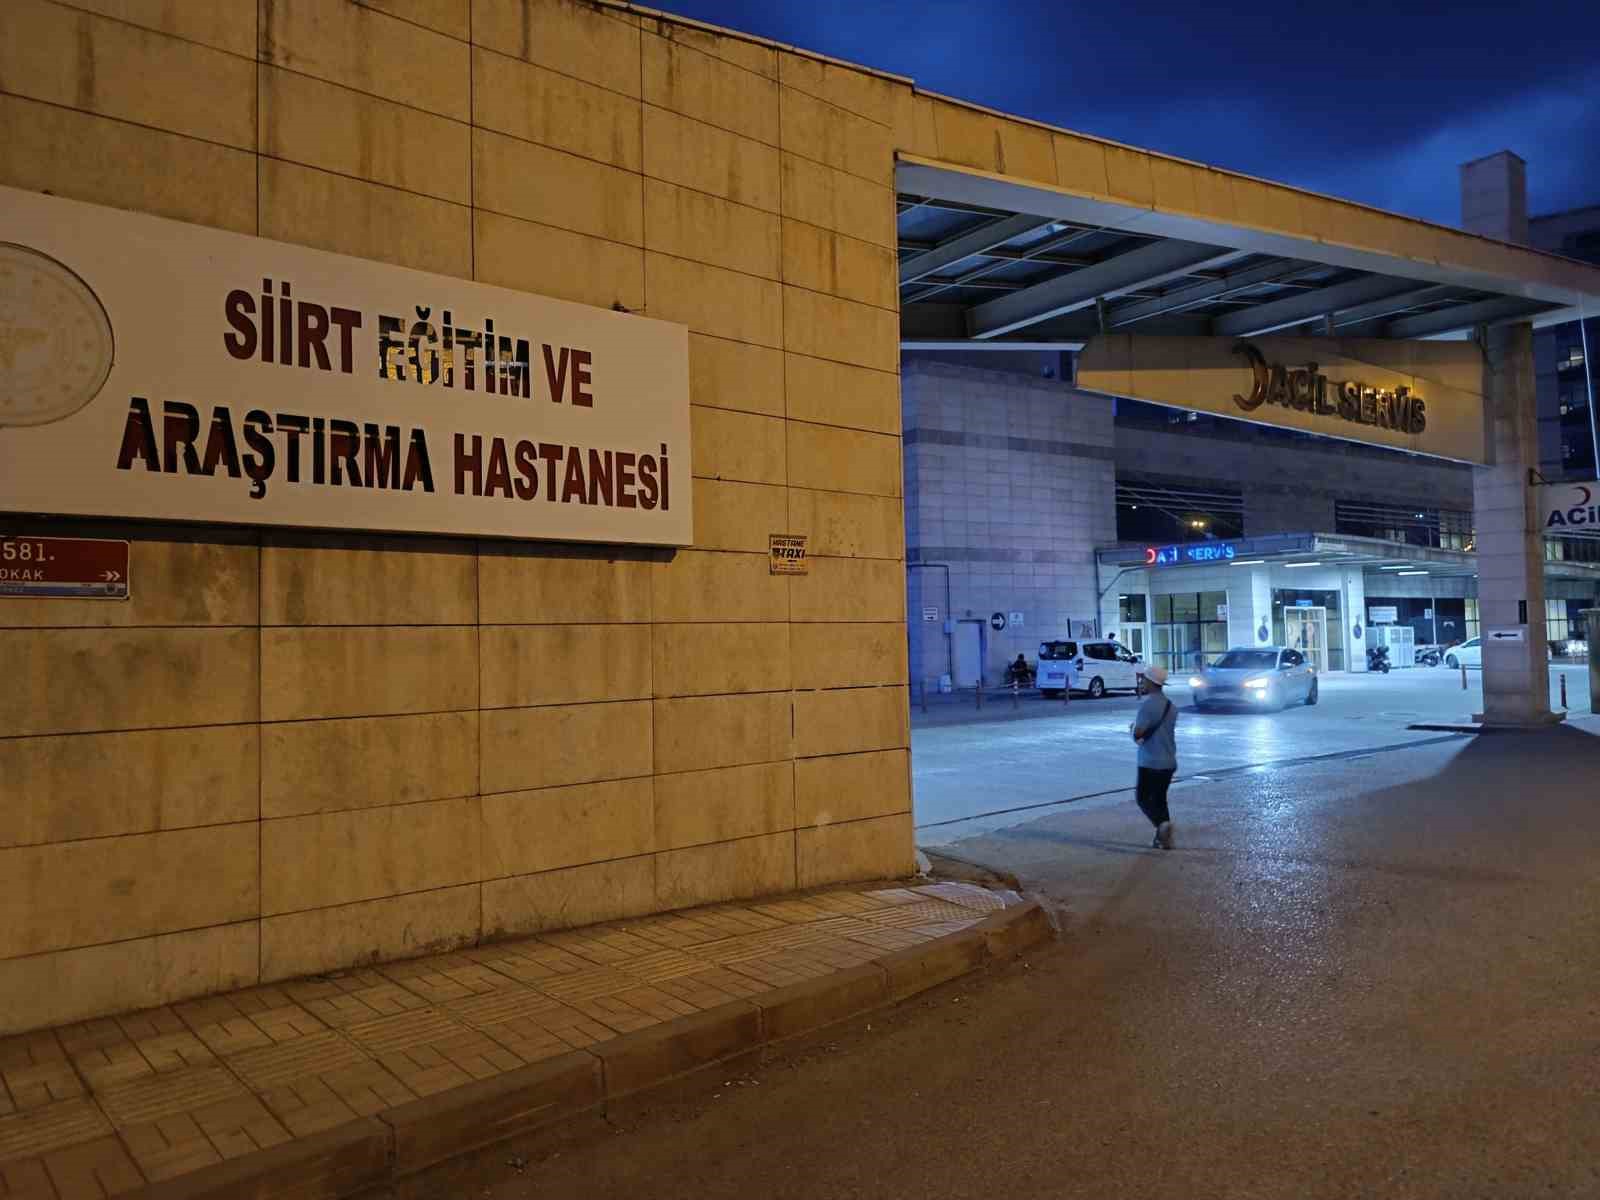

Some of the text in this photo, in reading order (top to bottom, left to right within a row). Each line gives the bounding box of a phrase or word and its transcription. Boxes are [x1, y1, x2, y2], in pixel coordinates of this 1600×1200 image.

[224, 278, 594, 408] SİİRT EĞİTİM VE
[116, 396, 670, 511] ARAŞTIRMA HASTANESİ
[3, 541, 55, 562] 581.
